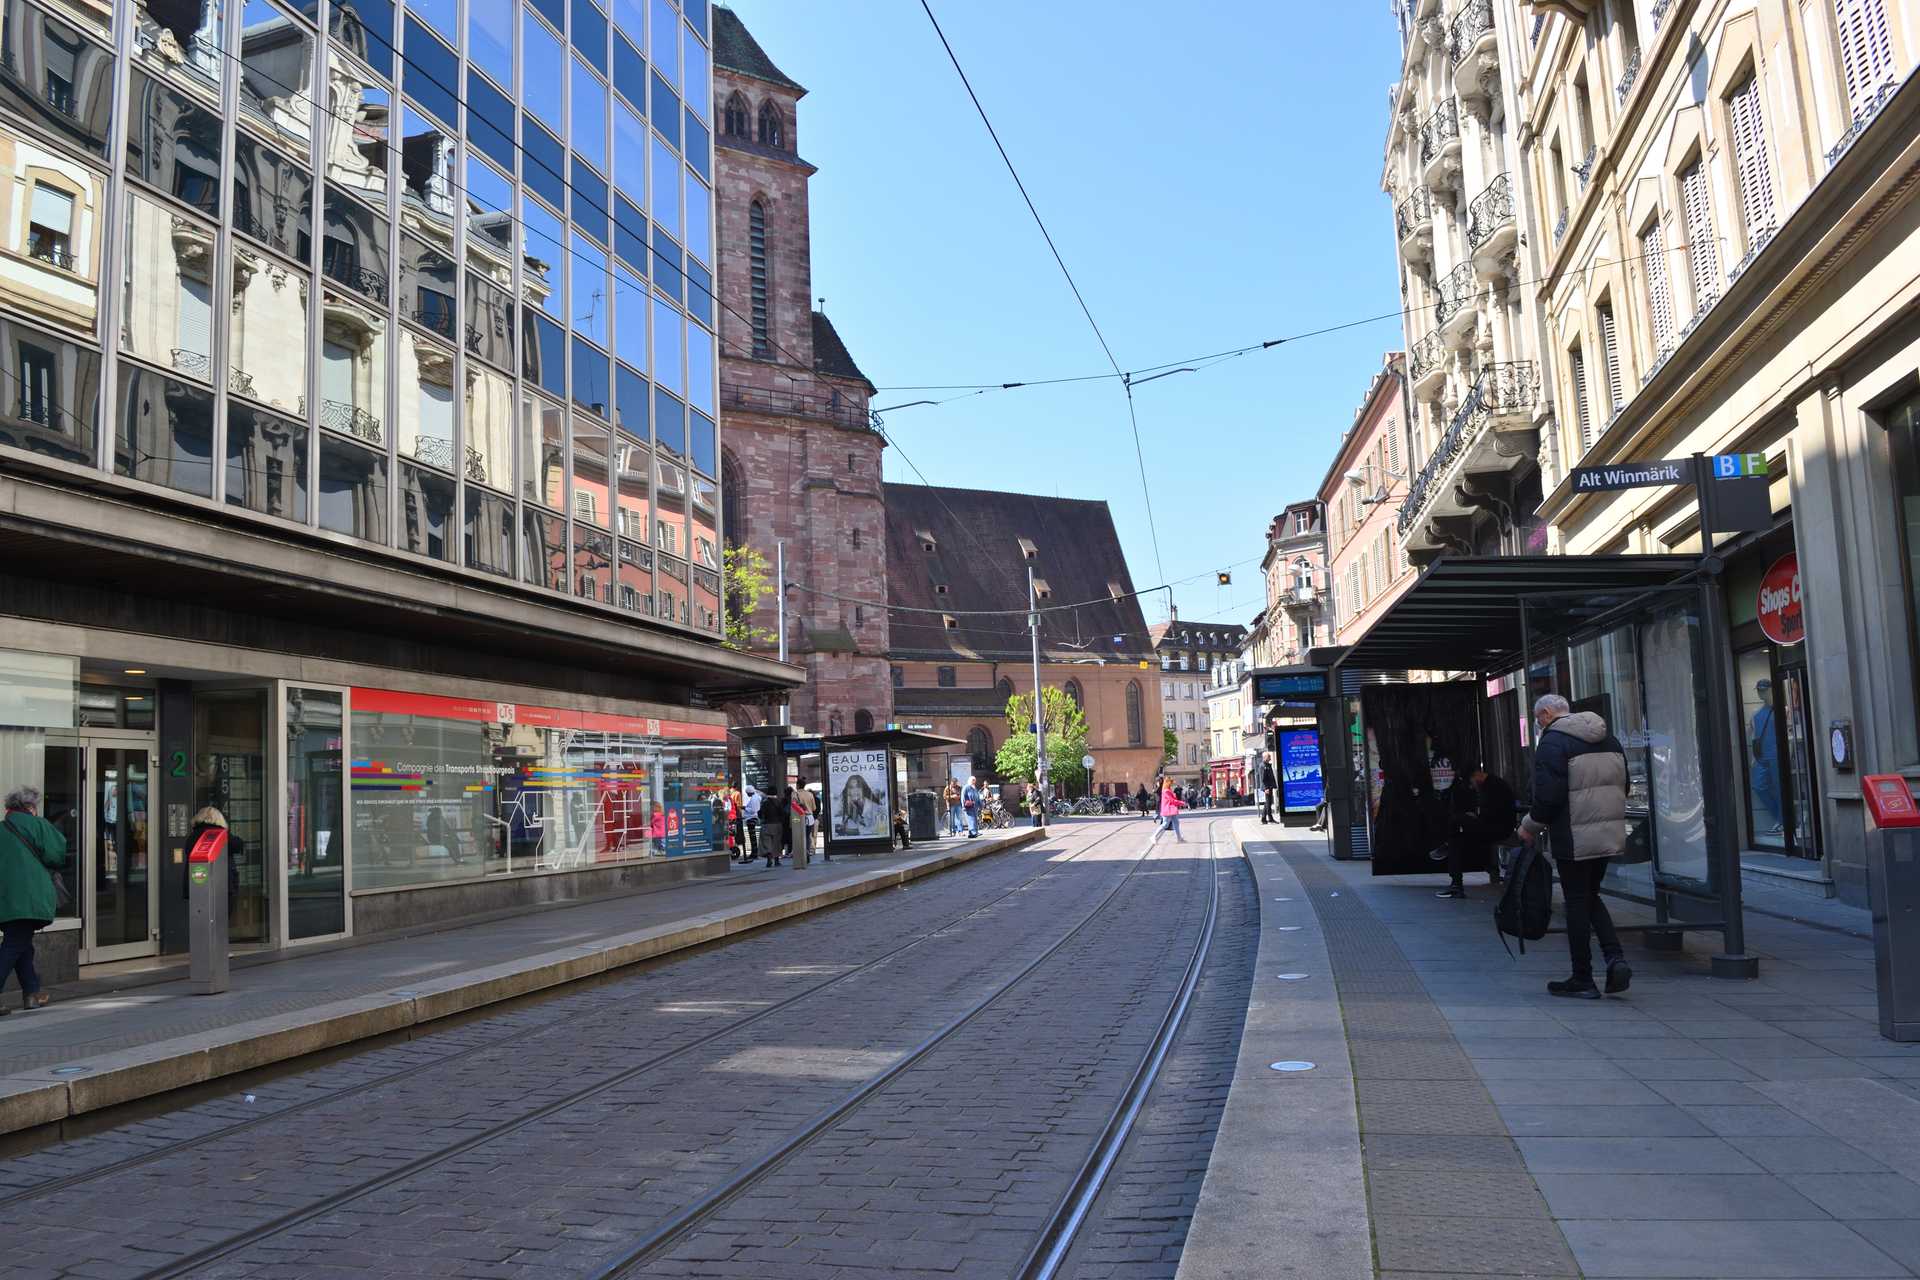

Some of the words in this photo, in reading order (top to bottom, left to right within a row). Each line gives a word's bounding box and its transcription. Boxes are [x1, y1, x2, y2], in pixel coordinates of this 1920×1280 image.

[1720, 455, 1735, 477] B
[1747, 453, 1760, 475] F
[1579, 472, 1601, 488] Alt
[1603, 464, 1680, 487] Winmärik
[1761, 586, 1790, 615] Shops
[498, 705, 513, 721] CTS
[171, 751, 187, 777] 2
[221, 758, 228, 772] 6
[832, 754, 860, 765] EAU
[866, 753, 885, 763] DE
[397, 761, 433, 775] Compagnie
[433, 763, 445, 773] des
[445, 763, 475, 775] Transports
[832, 763, 885, 773] ROCHAS
[222, 780, 229, 794] 5
